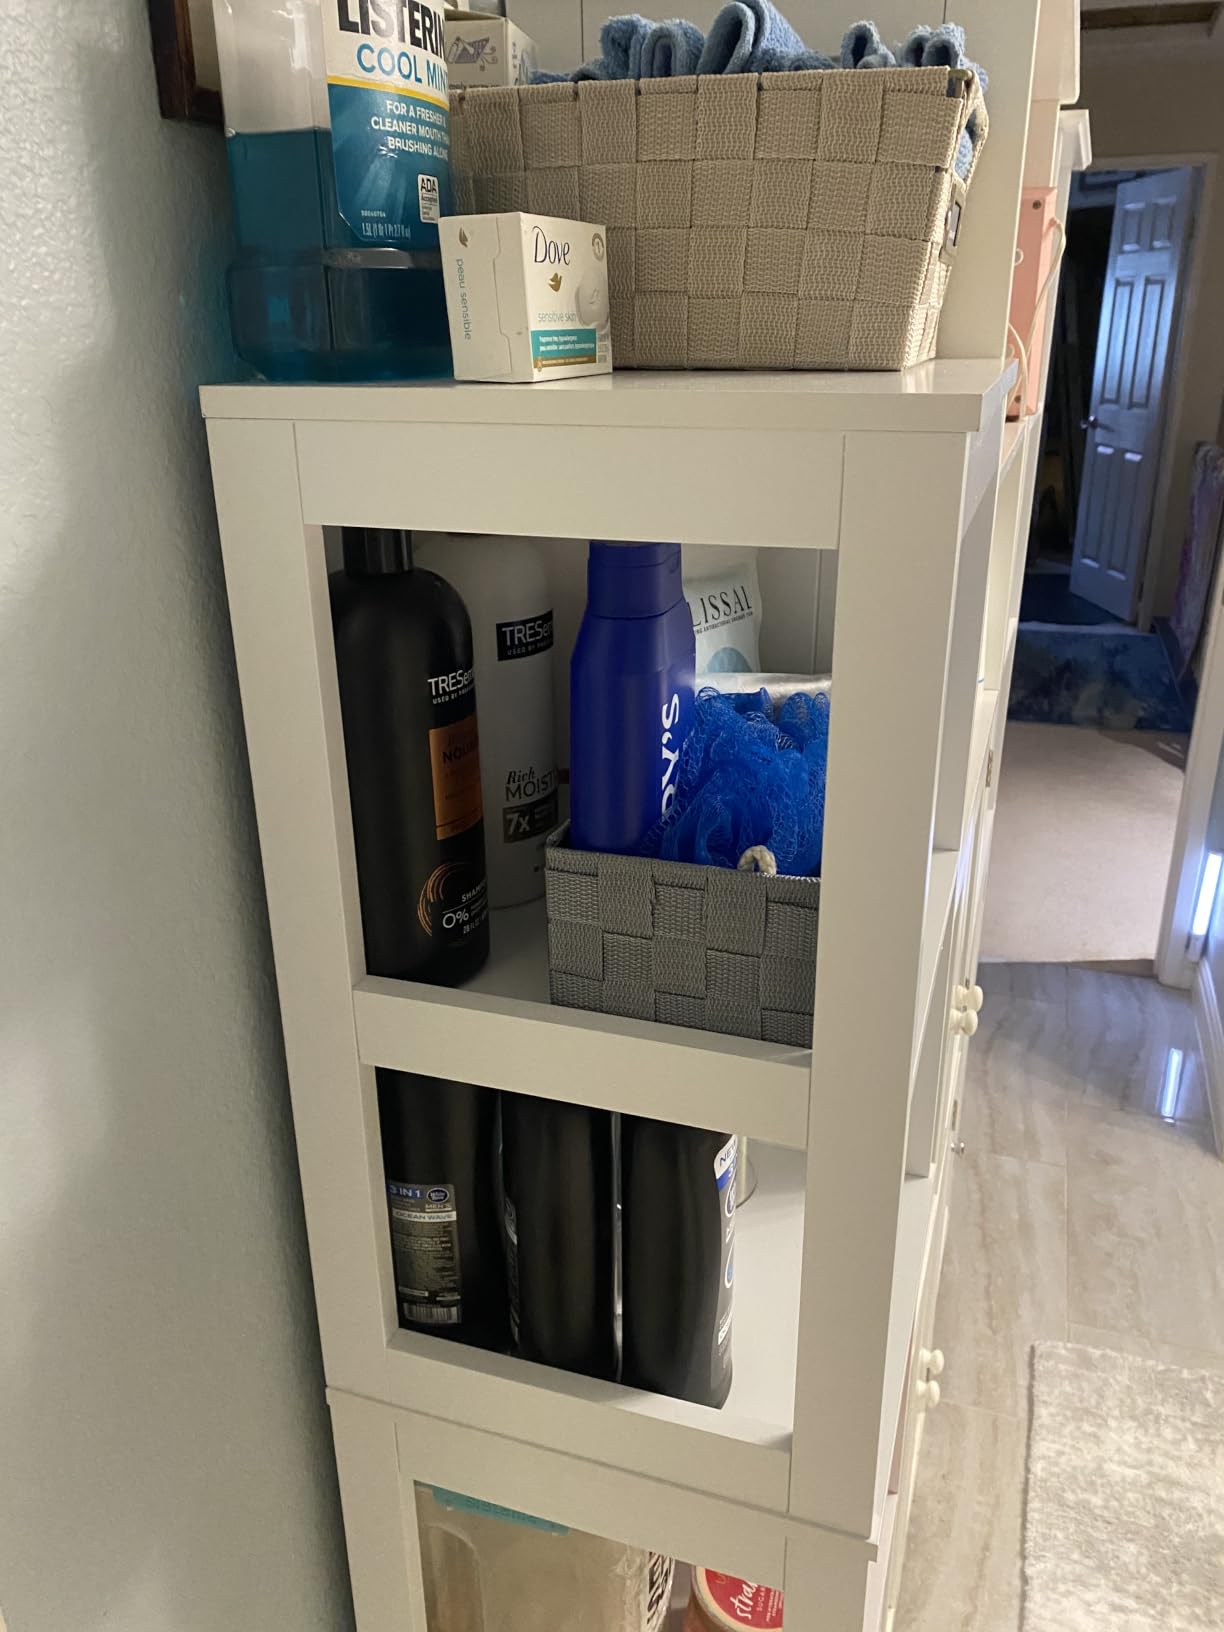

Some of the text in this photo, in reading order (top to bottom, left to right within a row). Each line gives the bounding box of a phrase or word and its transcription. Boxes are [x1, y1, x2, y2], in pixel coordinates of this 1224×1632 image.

[356, 43, 423, 84] COOL
[386, 100, 407, 116] FOR
[409, 105, 416, 118] A
[416, 107, 443, 126] FRESHER
[371, 116, 417, 136] CLEANER
[418, 124, 441, 142] MOUTH
[387, 135, 432, 156] BRUSHING
[420, 177, 437, 193] ADA
[532, 225, 571, 266] Dove
[456, 258, 472, 340] peau sensible
[537, 311, 577, 323] sensitive skin
[506, 766, 536, 785] Rich
[442, 907, 470, 929] 0%
[389, 1184, 398, 1195] 3
[399, 1186, 412, 1197] IN
[415, 1189, 421, 1198] 1
[395, 1211, 454, 1221] OCEAN WAVE
